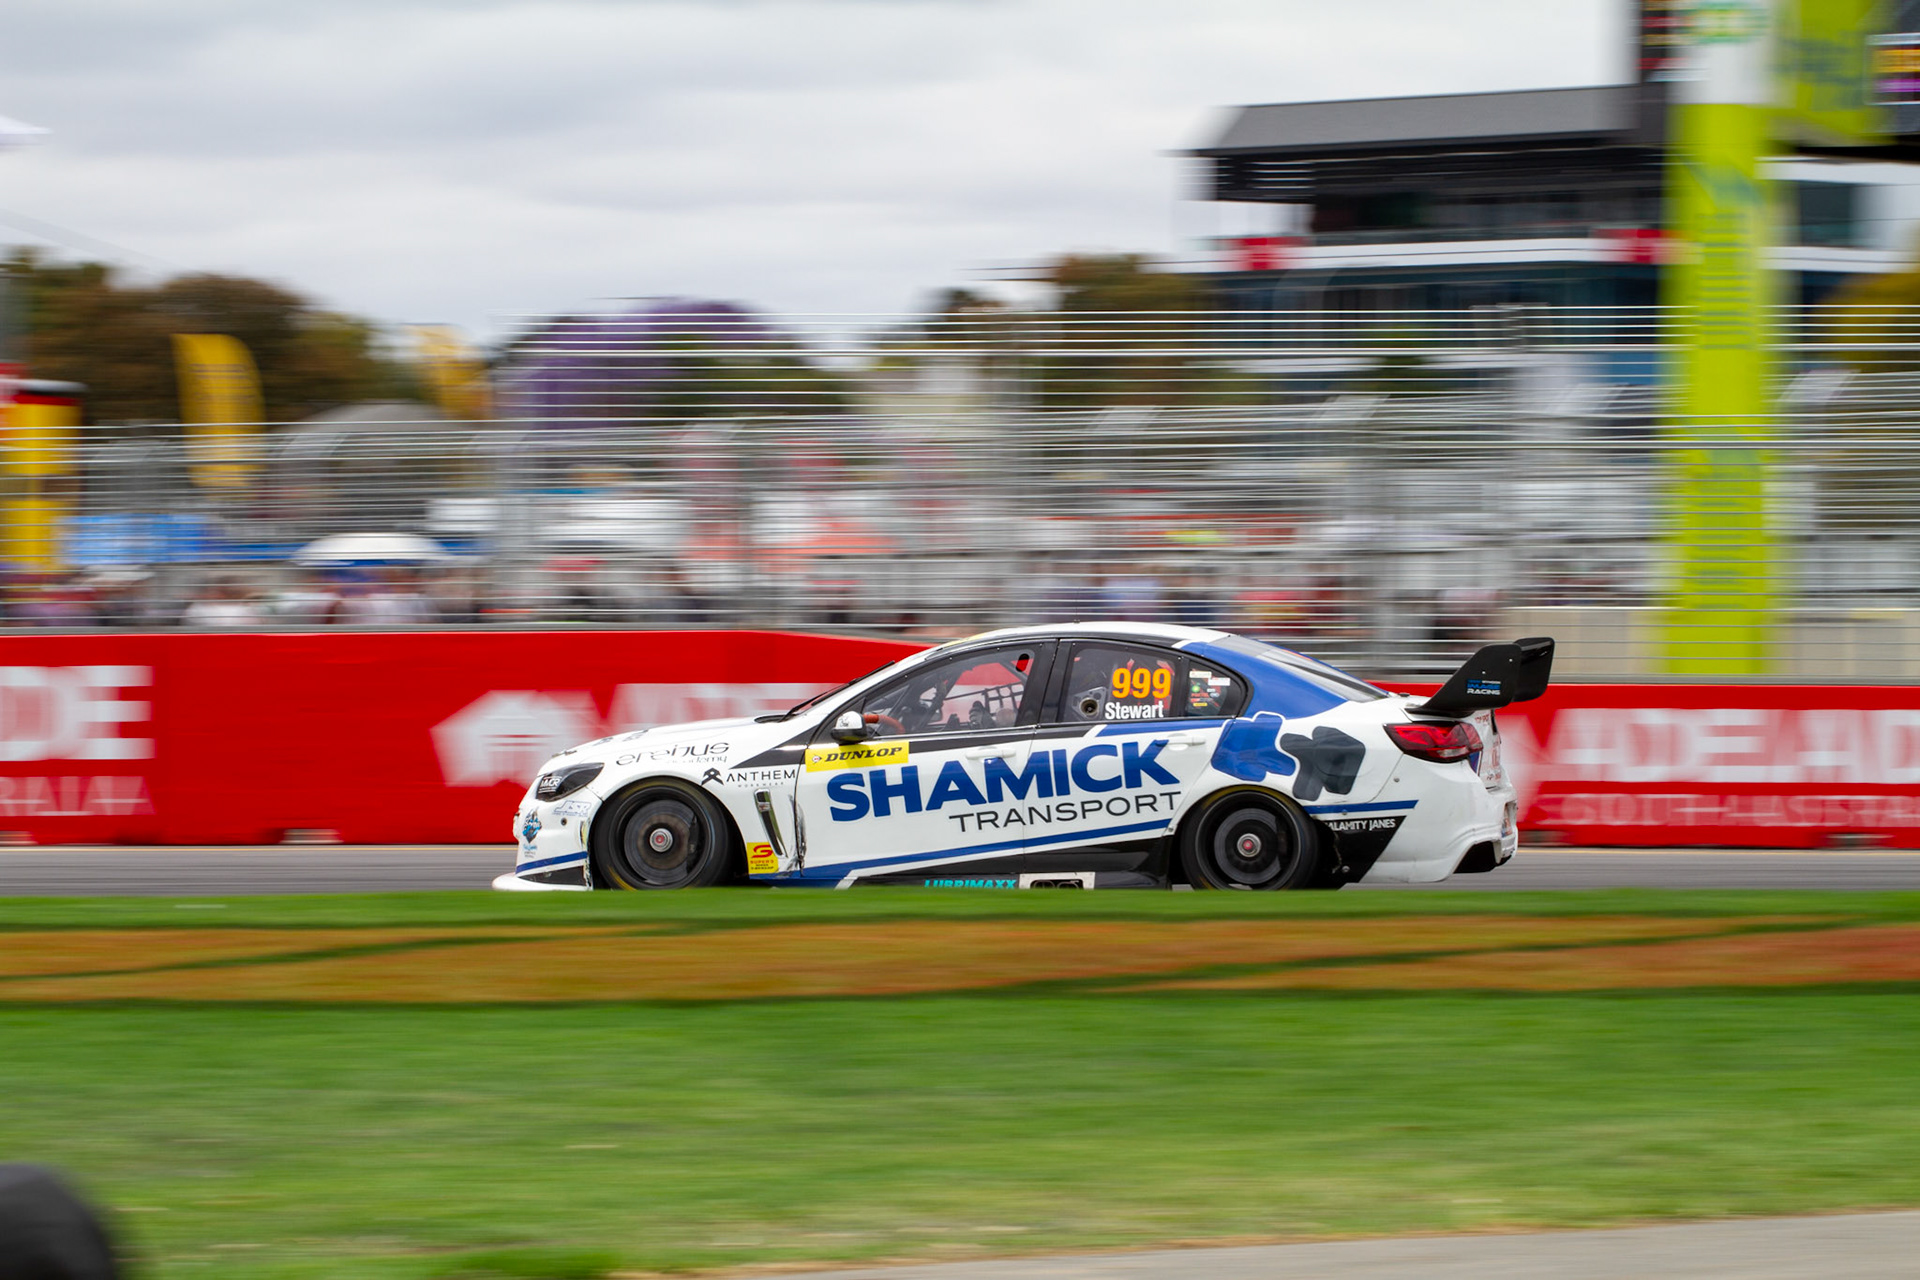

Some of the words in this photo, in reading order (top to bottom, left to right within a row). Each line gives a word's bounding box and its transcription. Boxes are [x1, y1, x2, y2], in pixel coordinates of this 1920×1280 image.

[1111, 667, 1172, 699] 999
[1466, 688, 1501, 696] RACING
[1104, 700, 1165, 720] Stewart
[824, 747, 903, 763] DUNLOP
[726, 768, 796, 783] ANTHEM
[826, 739, 1181, 822] SHAMICK
[948, 791, 1182, 833] TRANSPORT
[1324, 820, 1368, 832] ALAMITY
[1368, 818, 1397, 832] JANES
